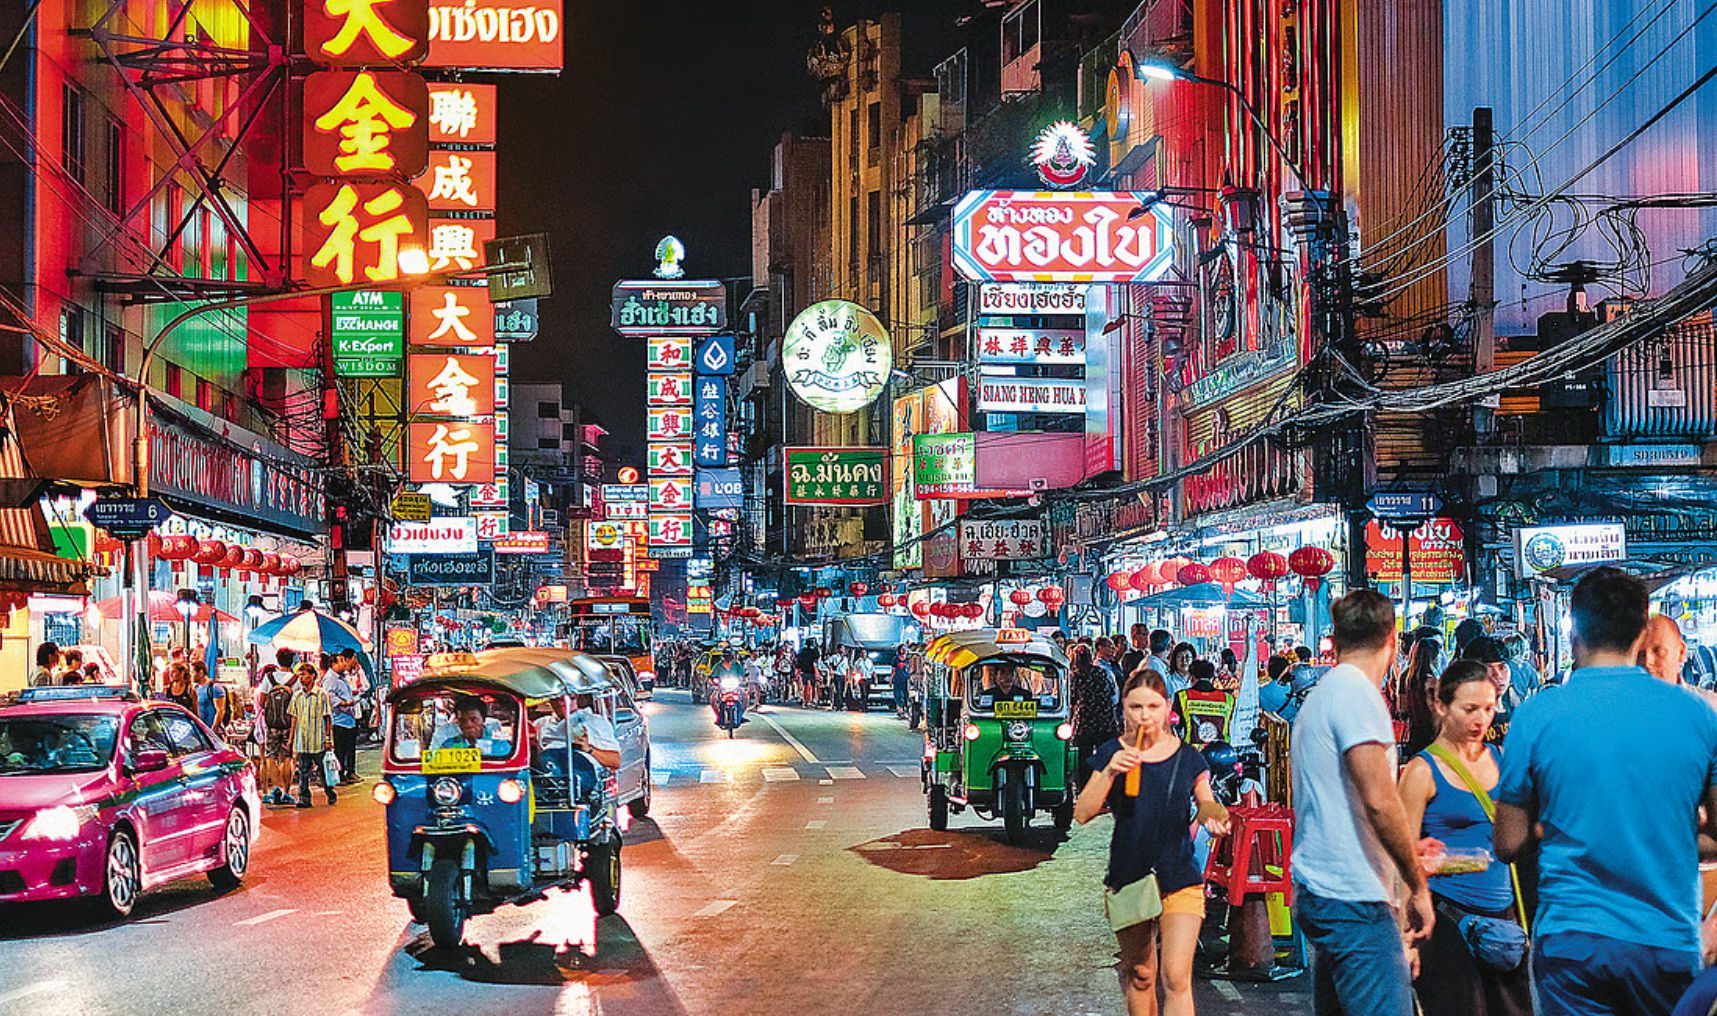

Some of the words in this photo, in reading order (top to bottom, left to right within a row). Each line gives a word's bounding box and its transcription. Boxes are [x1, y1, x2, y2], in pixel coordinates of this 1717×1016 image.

[976, 205, 1152, 267] ทองใบ
[352, 291, 383, 305] ATM
[336, 317, 398, 331] EXCHANGE
[338, 363, 397, 372] WISDOM
[983, 384, 1017, 402] SIANG
[1020, 386, 1050, 404] HENG
[1052, 386, 1076, 405] HUA
[714, 482, 743, 495] UOB
[1421, 497, 1434, 510] 11
[148, 504, 158, 519] 6
[1001, 631, 1026, 640] TAXI
